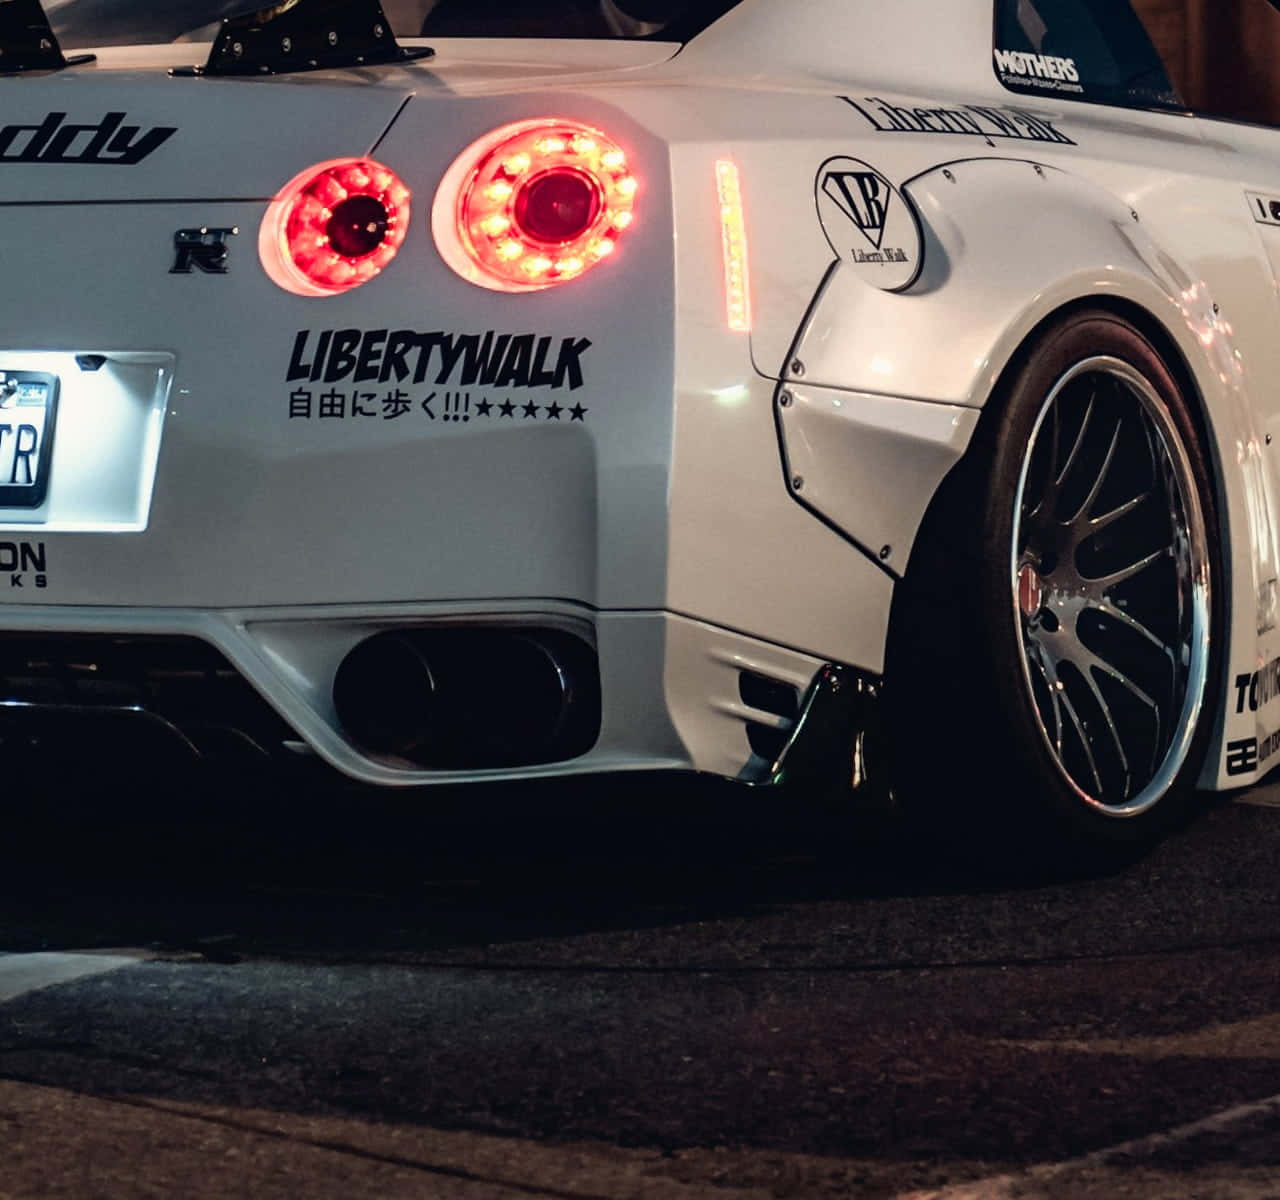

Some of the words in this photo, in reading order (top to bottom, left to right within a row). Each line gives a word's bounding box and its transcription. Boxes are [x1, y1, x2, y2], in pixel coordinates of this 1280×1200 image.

[993, 48, 1080, 83] MOTHERS
[834, 95, 996, 148] Liberty
[958, 103, 1079, 146] Walk
[851, 248, 885, 267] Liberty
[883, 248, 909, 263] Walk
